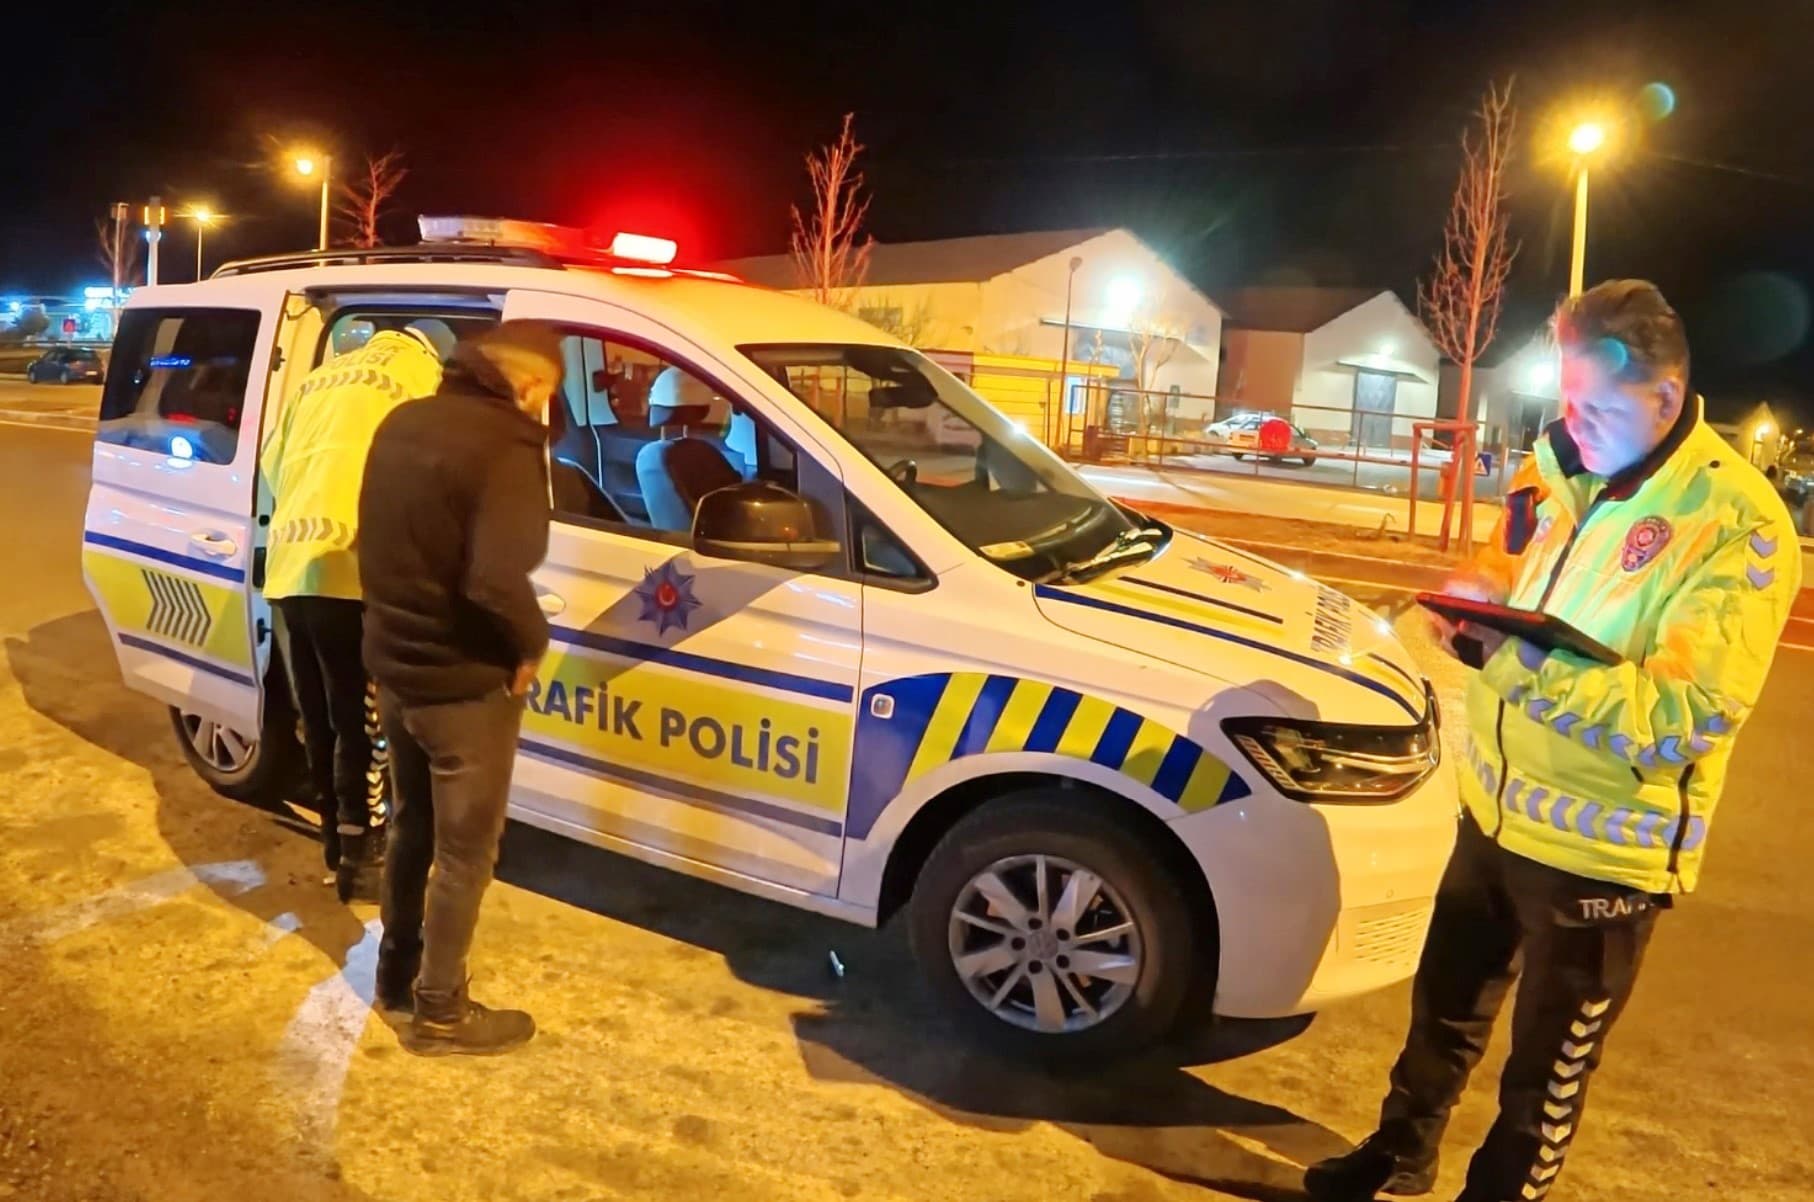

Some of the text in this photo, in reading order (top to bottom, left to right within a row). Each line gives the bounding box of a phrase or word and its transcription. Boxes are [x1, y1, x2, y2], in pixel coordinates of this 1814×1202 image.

[526, 677, 819, 785] RAFİK POLİSİ
[1579, 897, 1646, 919] TRA
